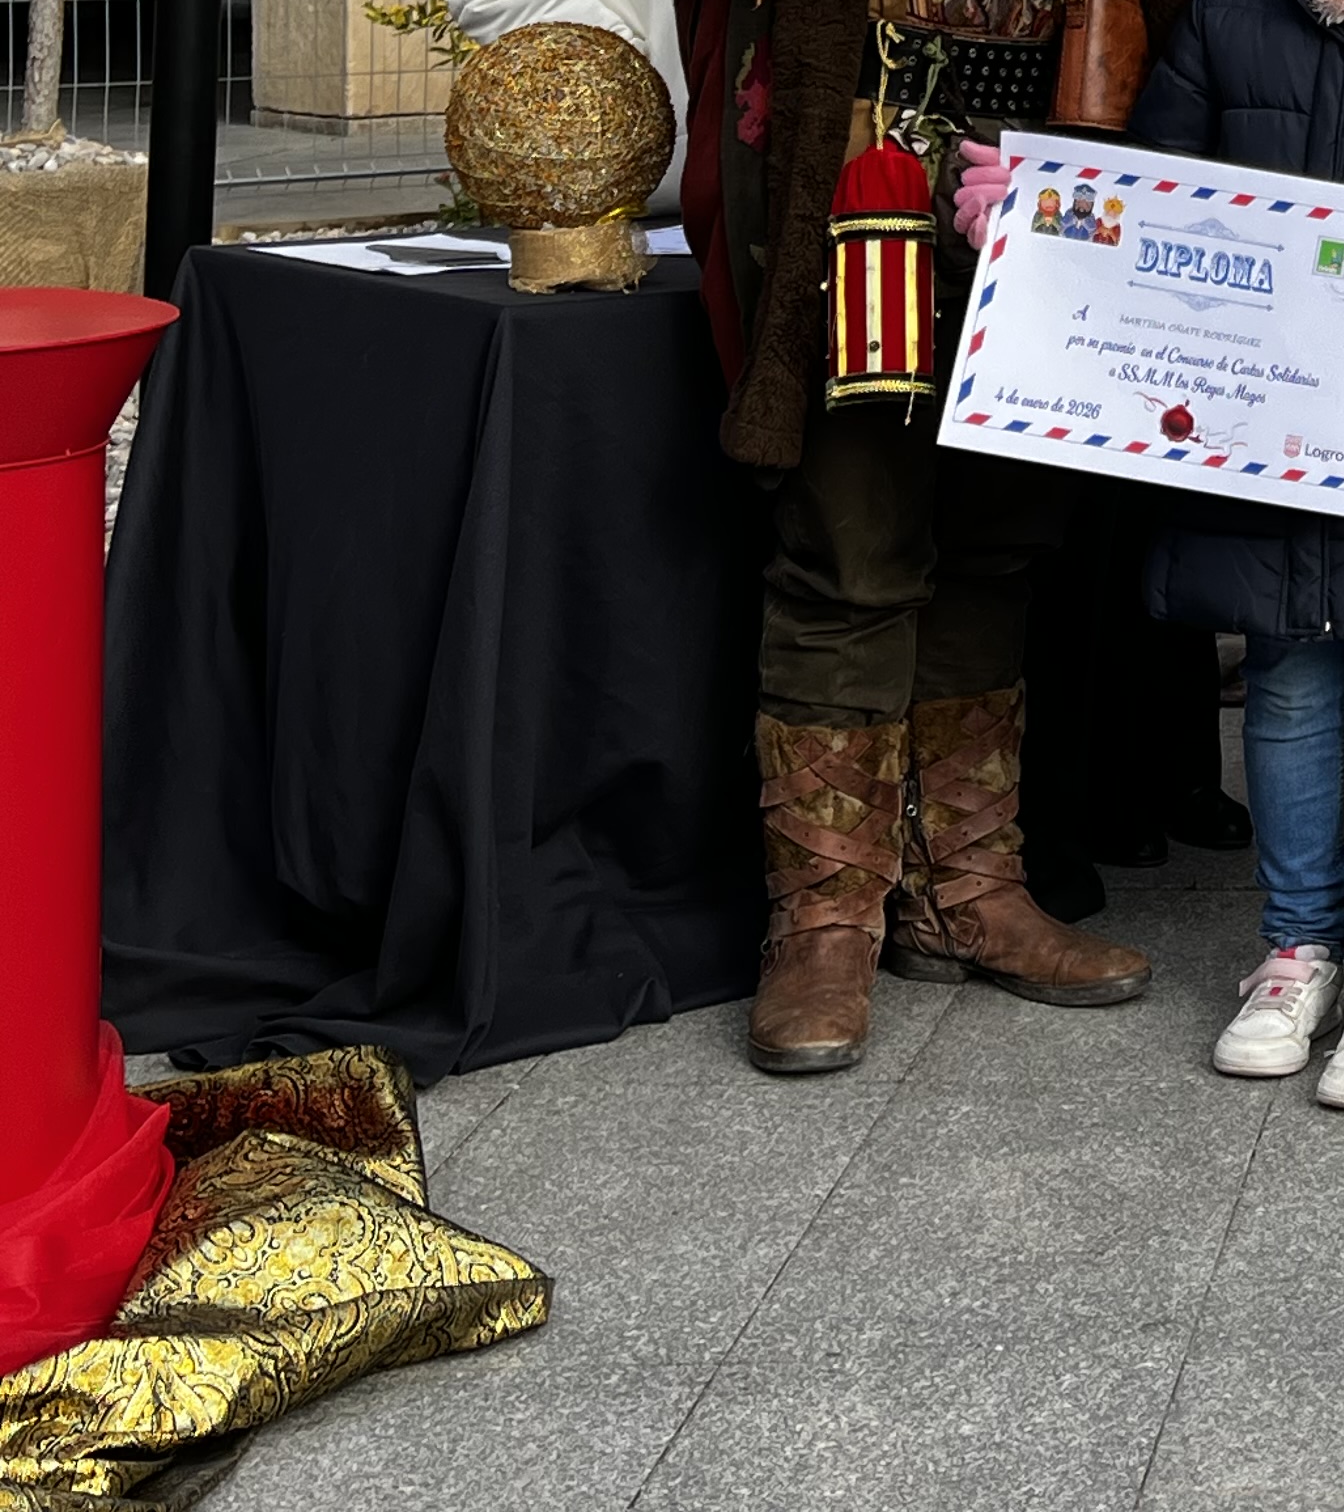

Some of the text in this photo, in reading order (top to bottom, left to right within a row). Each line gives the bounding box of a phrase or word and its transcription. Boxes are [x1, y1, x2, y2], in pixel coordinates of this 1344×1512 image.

[1135, 237, 1273, 294] DIPLOMA
[1072, 304, 1090, 321] A
[1120, 314, 1165, 330] MARTINA
[1065, 336, 1320, 388] por su premio en el Concurso de Cartas Solidarias
[994, 386, 1102, 420] 4 de enero de 2026
[1108, 368, 1116, 377] a
[1175, 372, 1189, 389] los
[1190, 376, 1225, 400] Reyes
[1226, 383, 1266, 407] Magos
